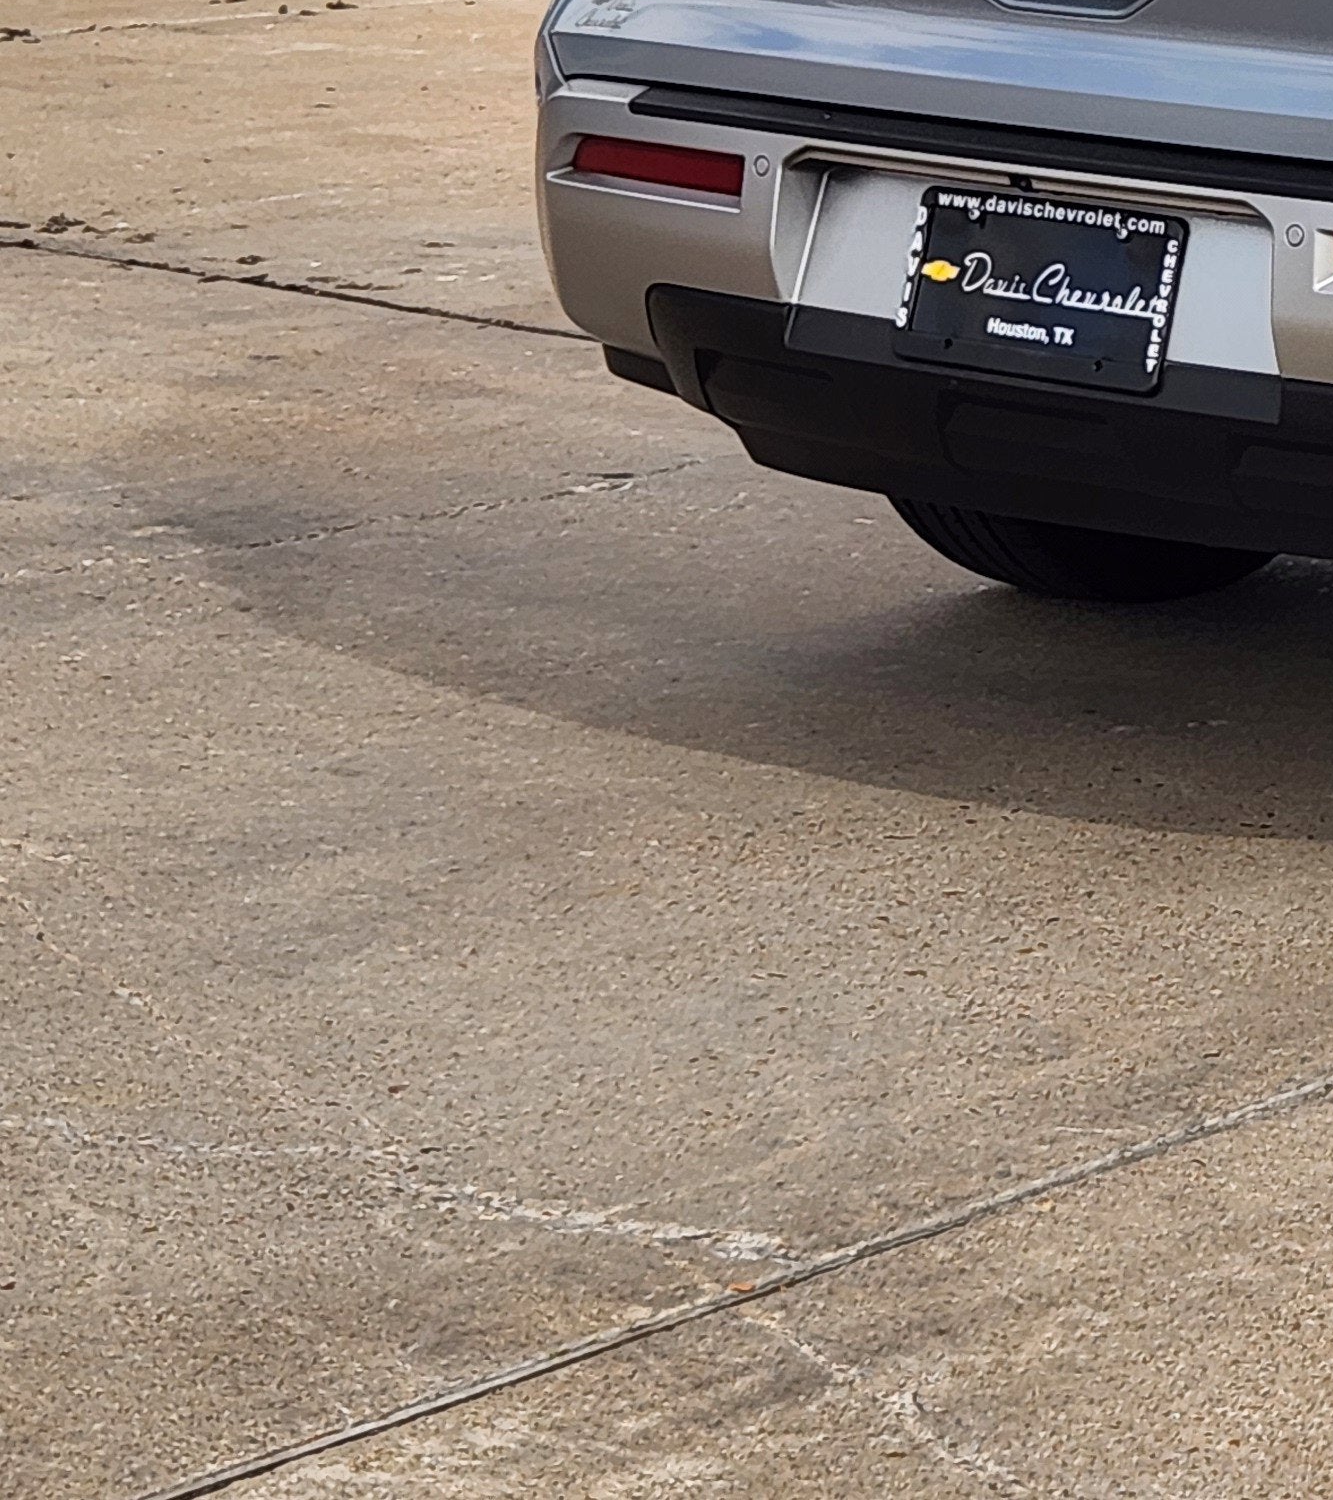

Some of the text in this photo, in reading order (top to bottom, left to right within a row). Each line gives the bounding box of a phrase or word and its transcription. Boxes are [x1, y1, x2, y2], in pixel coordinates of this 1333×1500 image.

[937, 191, 1166, 235] www.davischevrolet.com
[896, 205, 928, 329] DAVIS
[961, 251, 1032, 300] Davis
[1145, 238, 1179, 374] CHEVROLET
[986, 316, 1075, 346] Houston, TX
